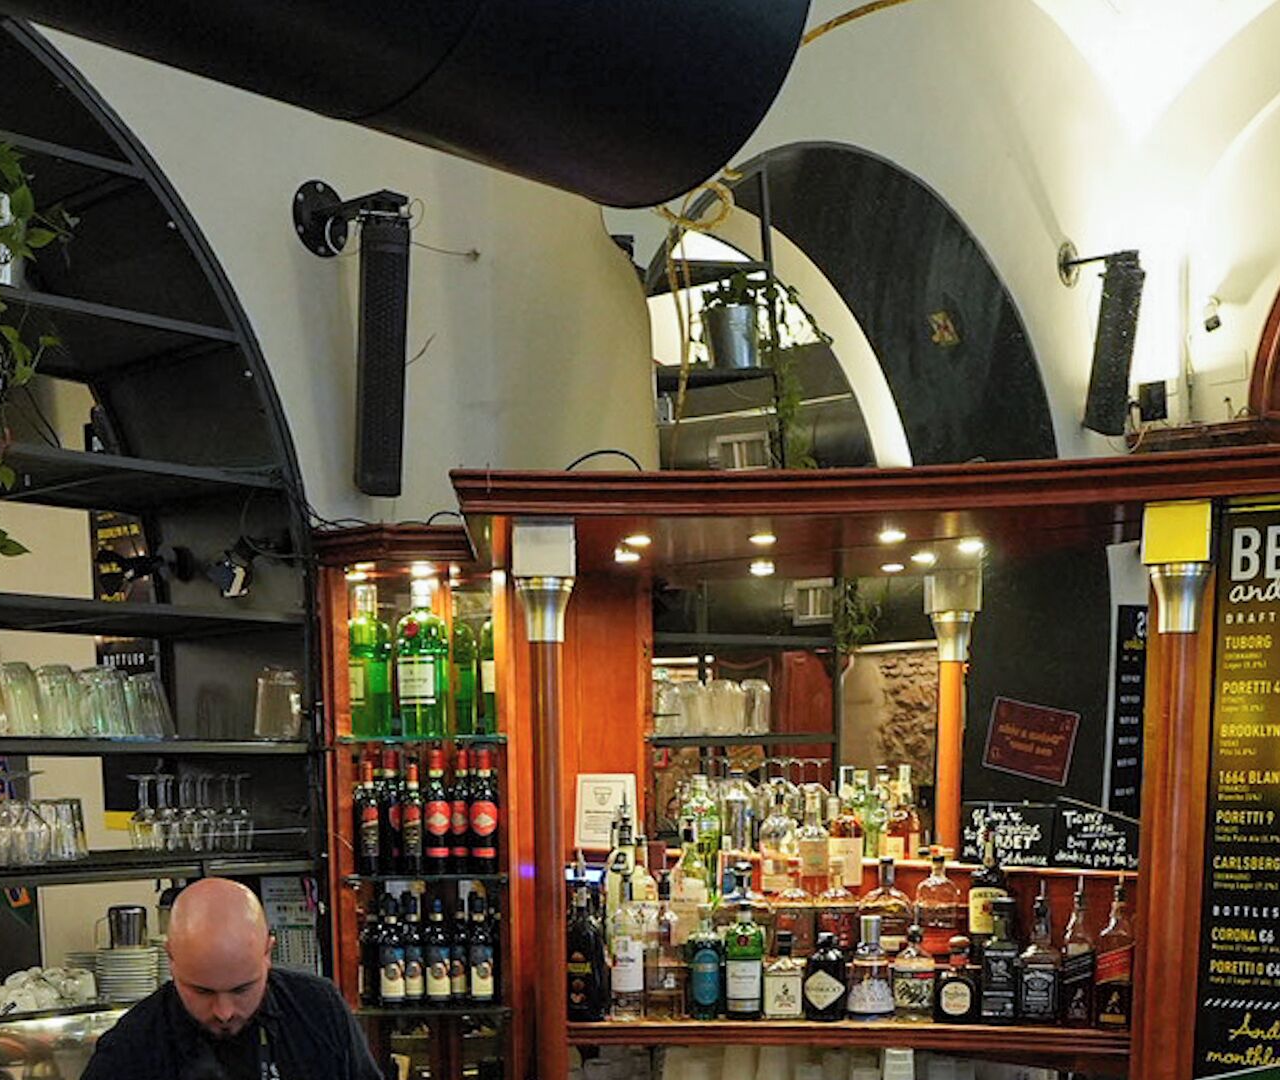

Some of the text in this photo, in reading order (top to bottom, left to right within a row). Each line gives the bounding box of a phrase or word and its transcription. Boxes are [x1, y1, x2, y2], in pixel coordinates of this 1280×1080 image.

[1225, 611, 1276, 625] DRAFT
[1224, 634, 1272, 649] TUBORG
[1222, 680, 1271, 694] PORETTI
[1219, 770, 1247, 784] 1664
[1215, 809, 1264, 825] PORETTI
[1212, 905, 1280, 919] BOTTLES
[1211, 927, 1275, 943] CORONA €6
[1209, 959, 1255, 975] PORETTI
